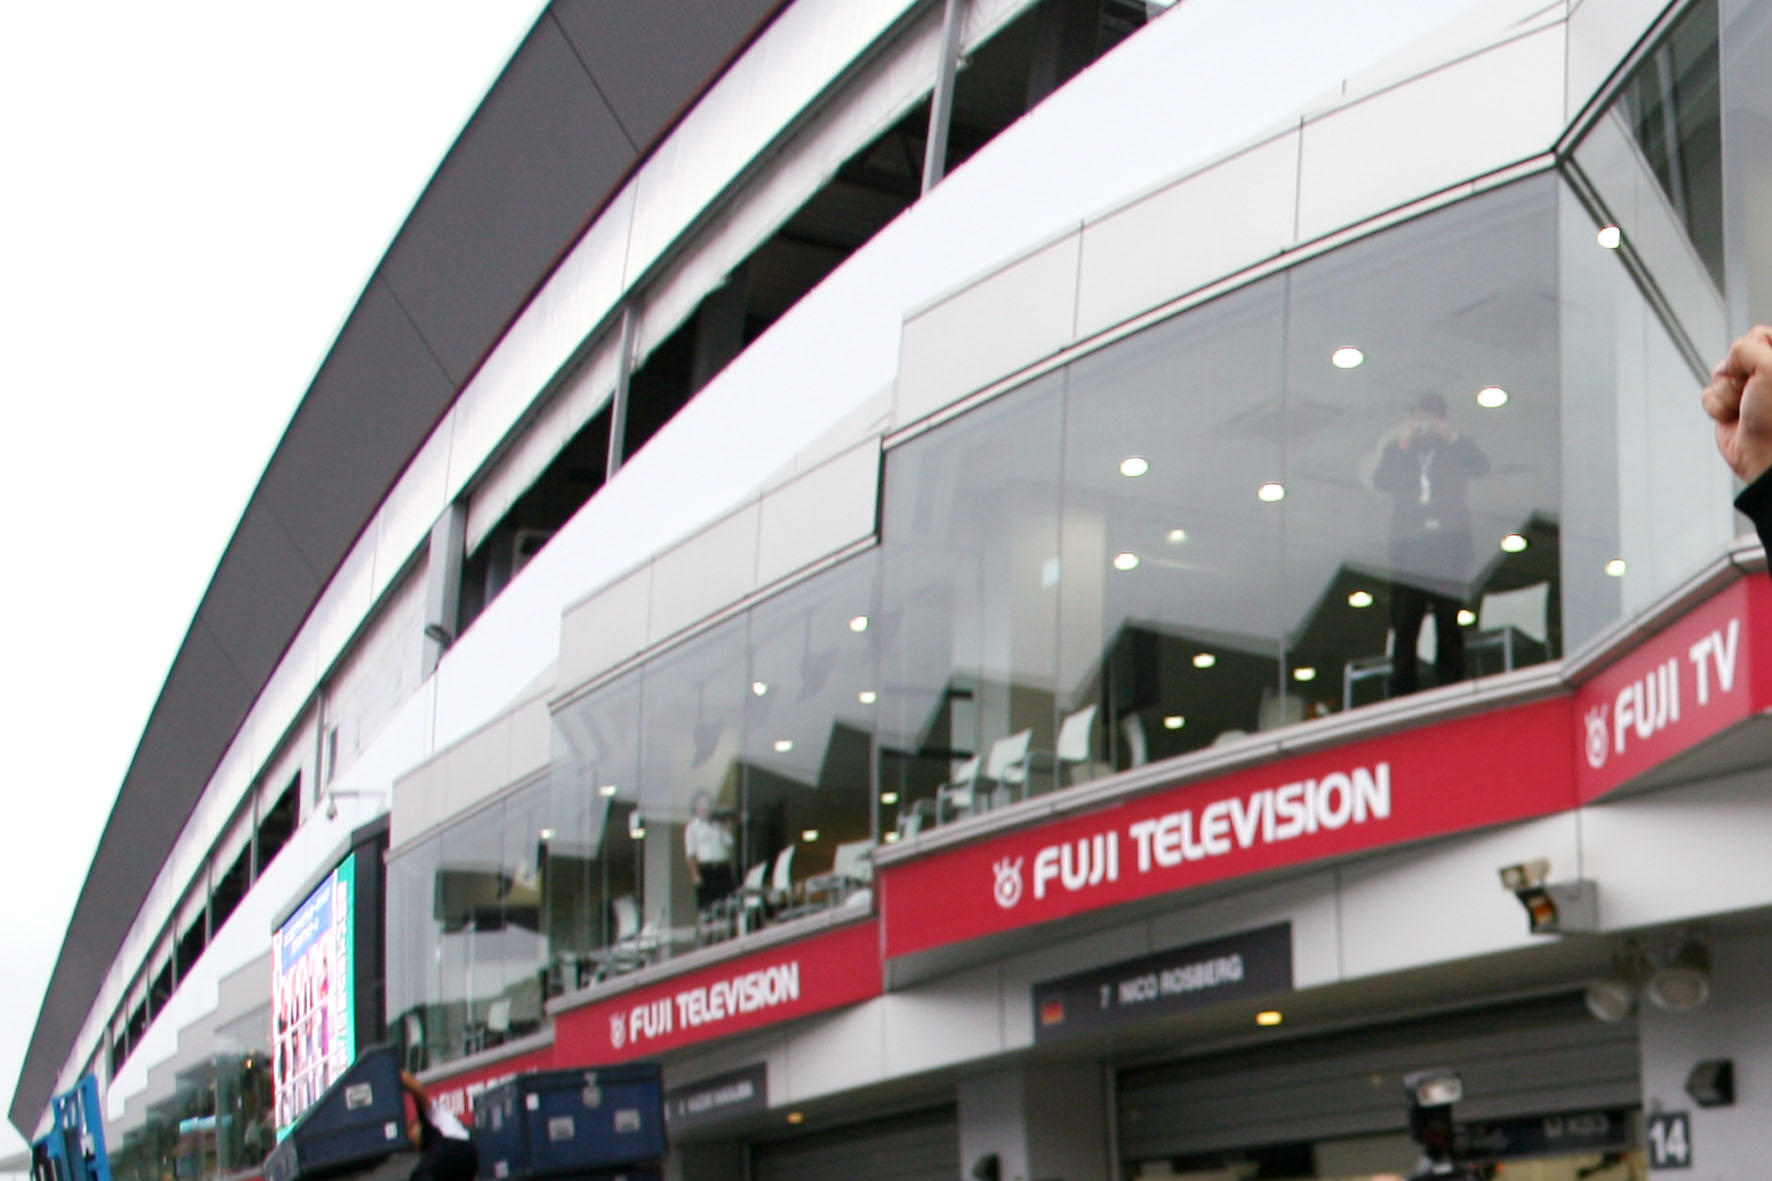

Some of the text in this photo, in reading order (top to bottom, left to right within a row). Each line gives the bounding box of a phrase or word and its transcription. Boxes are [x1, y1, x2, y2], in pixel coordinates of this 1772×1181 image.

[1614, 618, 1739, 755] FUJI TV
[1033, 761, 1391, 899] FUJI TELEVISION
[629, 961, 799, 1043] FUJI TELEVISION
[1100, 953, 1244, 1009] 7 NICO ROSBERG
[1649, 1118, 1688, 1164] 14
